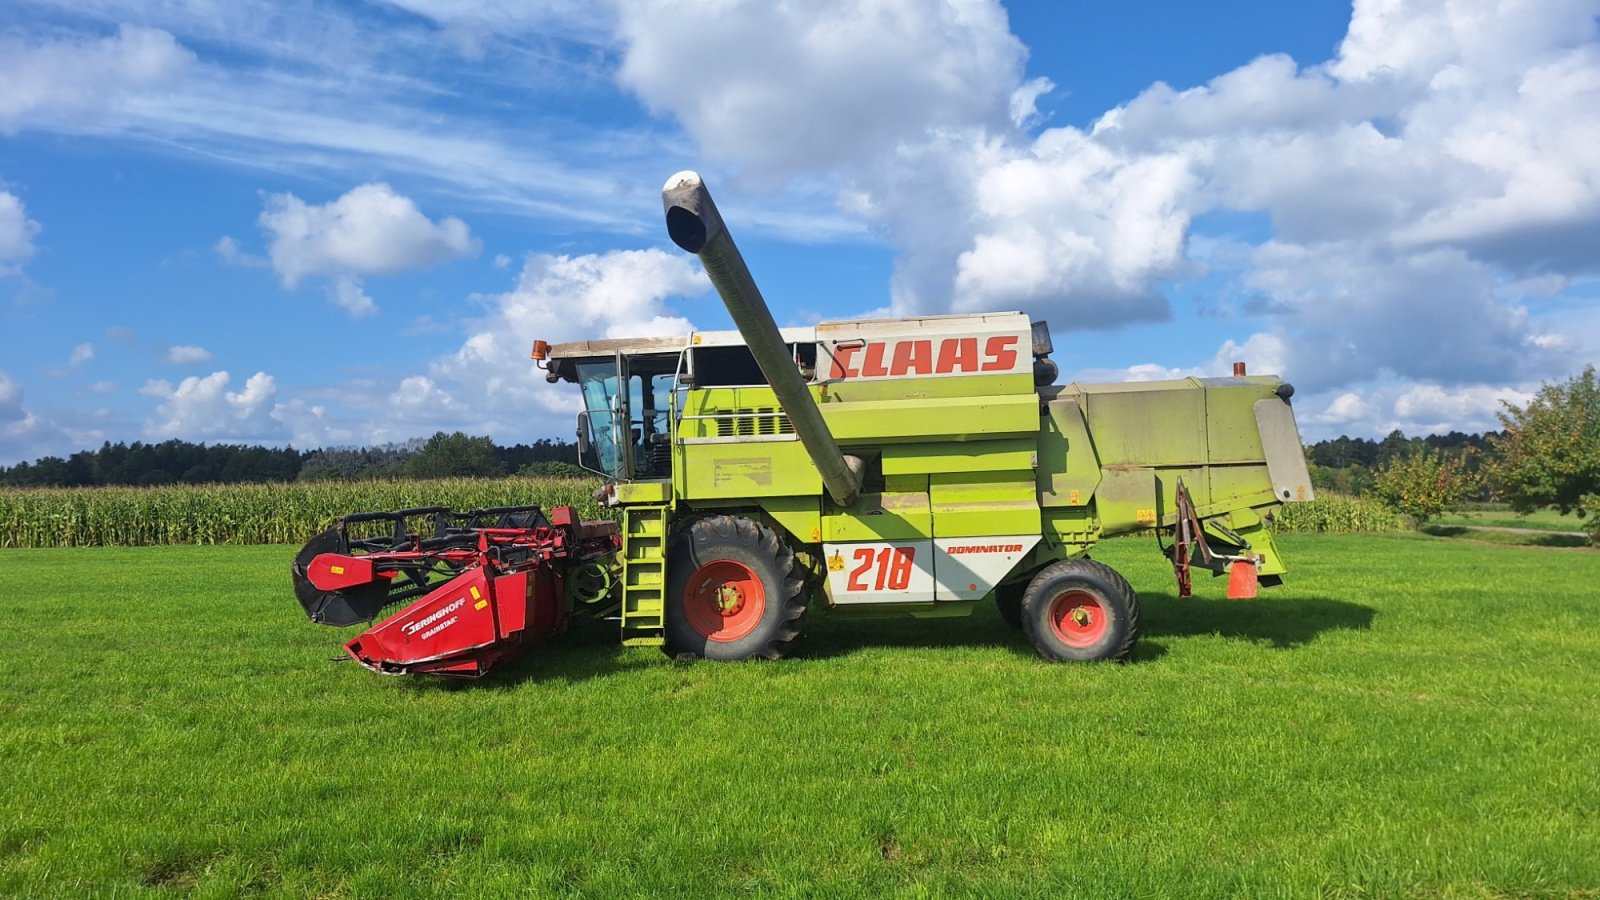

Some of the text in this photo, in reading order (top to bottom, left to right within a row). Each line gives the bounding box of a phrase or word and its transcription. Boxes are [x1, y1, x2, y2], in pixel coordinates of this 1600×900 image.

[829, 336, 1018, 378] CLAAS
[847, 547, 915, 591] 218
[947, 544, 1022, 555] DOMINATOR
[401, 597, 465, 635] GERINGHOFF
